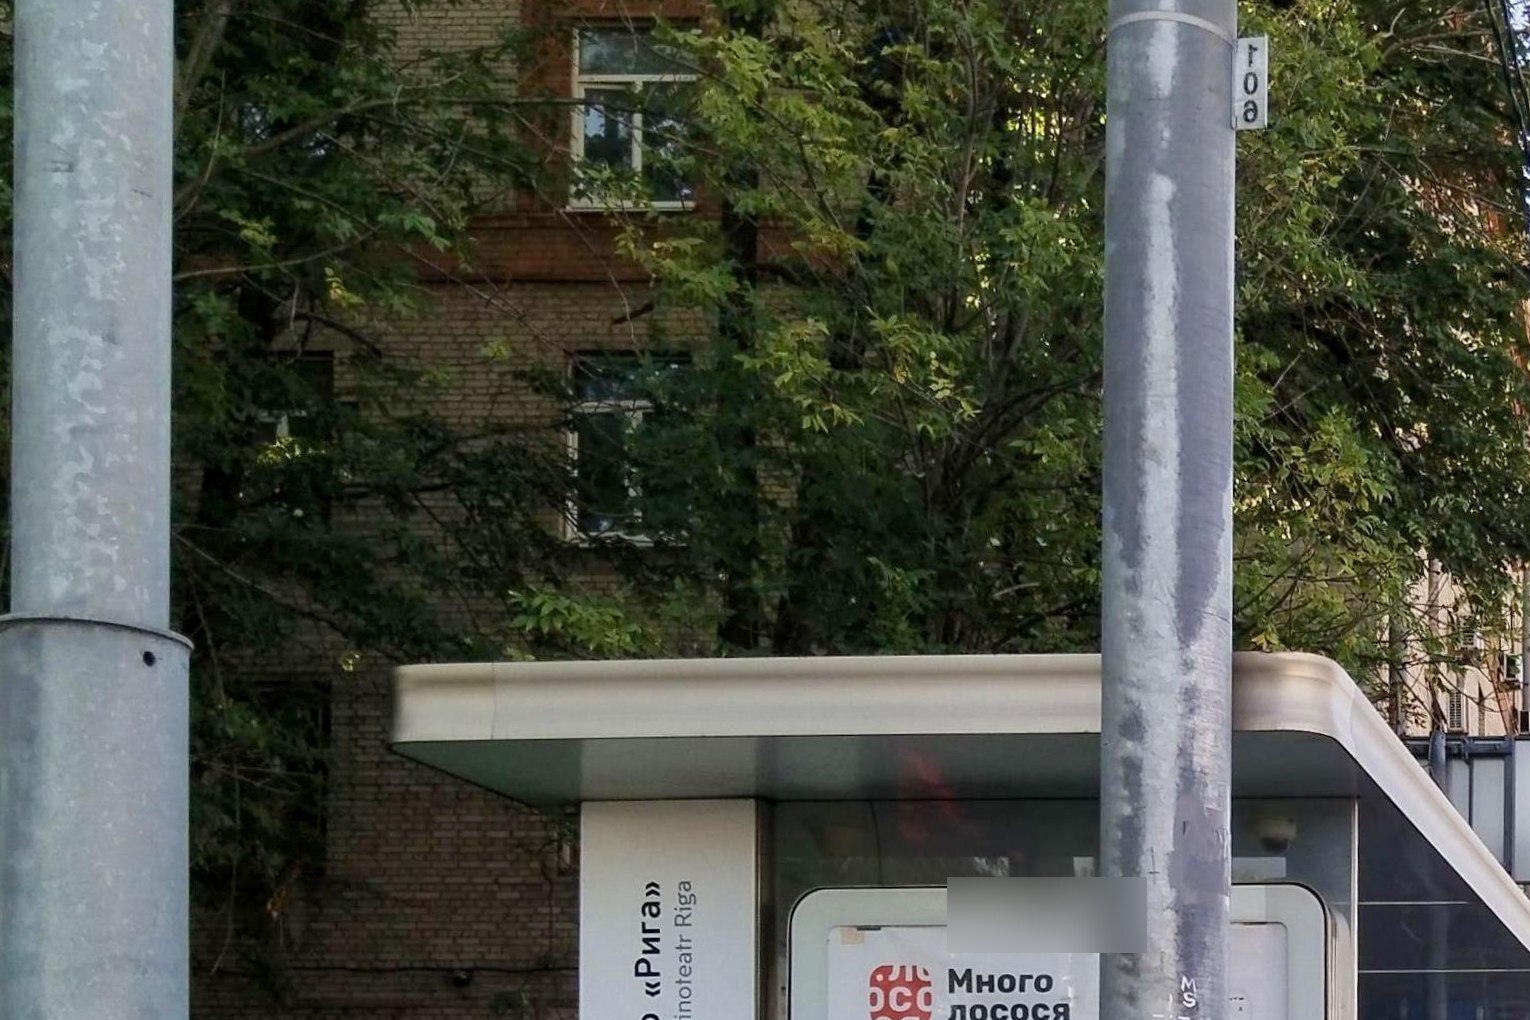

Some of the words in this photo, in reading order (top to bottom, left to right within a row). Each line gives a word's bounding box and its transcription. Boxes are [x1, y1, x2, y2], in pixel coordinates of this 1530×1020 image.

[674, 880, 697, 927] Riga
[634, 881, 661, 997] «Рига»
[948, 968, 1054, 994] Много
